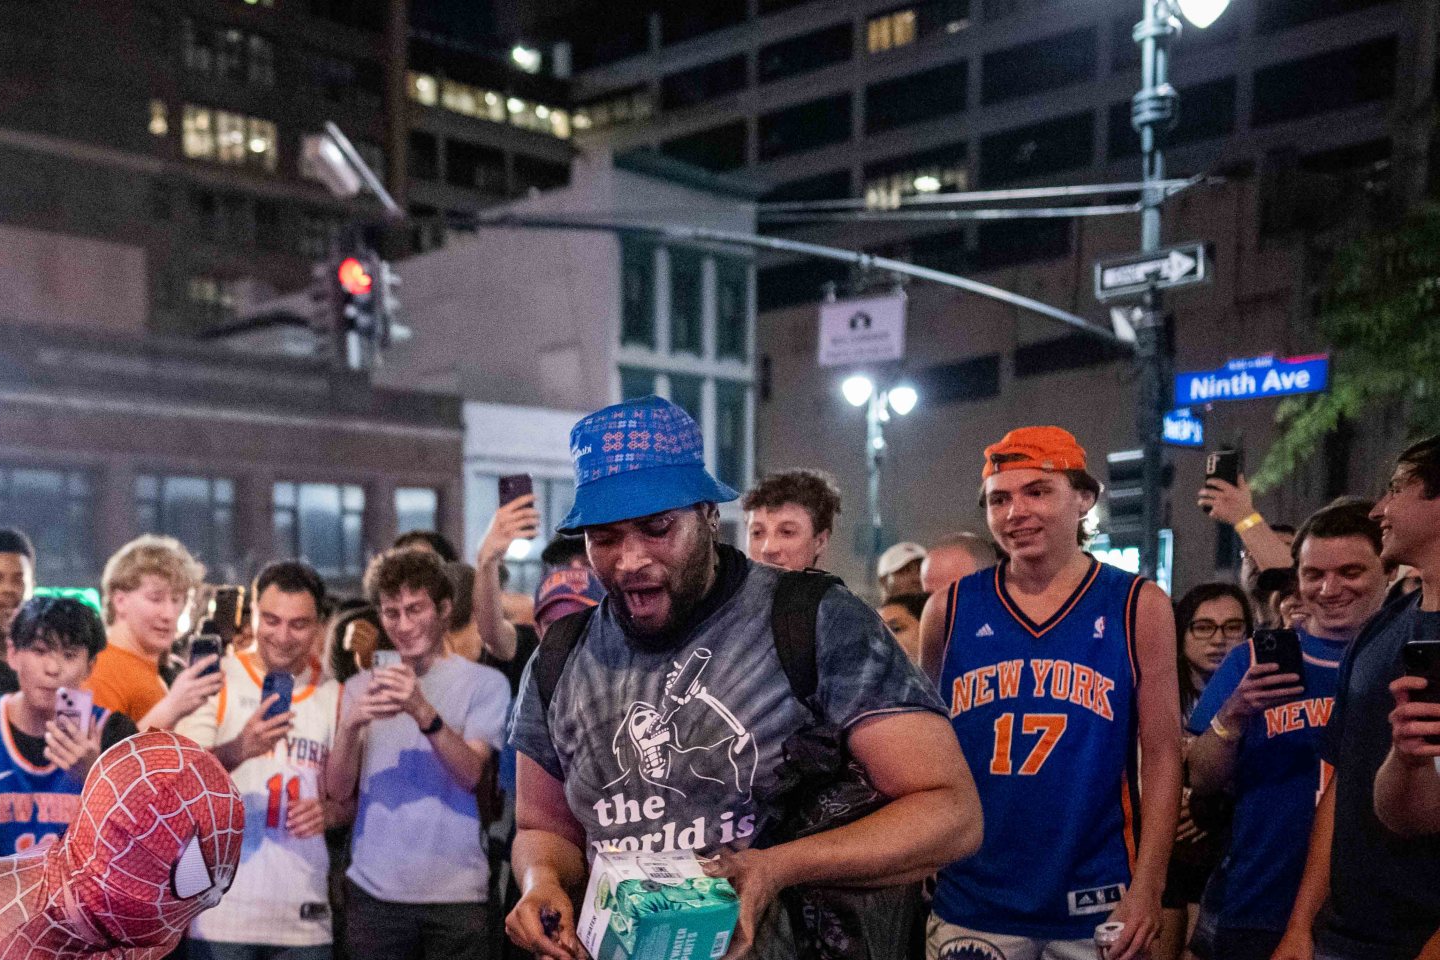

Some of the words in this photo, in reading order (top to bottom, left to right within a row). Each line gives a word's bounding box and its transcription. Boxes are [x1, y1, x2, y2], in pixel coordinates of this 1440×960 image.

[1190, 371, 1256, 400] Ninth
[1262, 369, 1310, 392] Ave
[951, 659, 1024, 720] NEW
[1030, 659, 1115, 721] YORK
[1264, 697, 1336, 739] NEW
[990, 713, 1068, 776] 17
[593, 793, 665, 827] the
[592, 817, 706, 854] world
[720, 811, 756, 844] is
